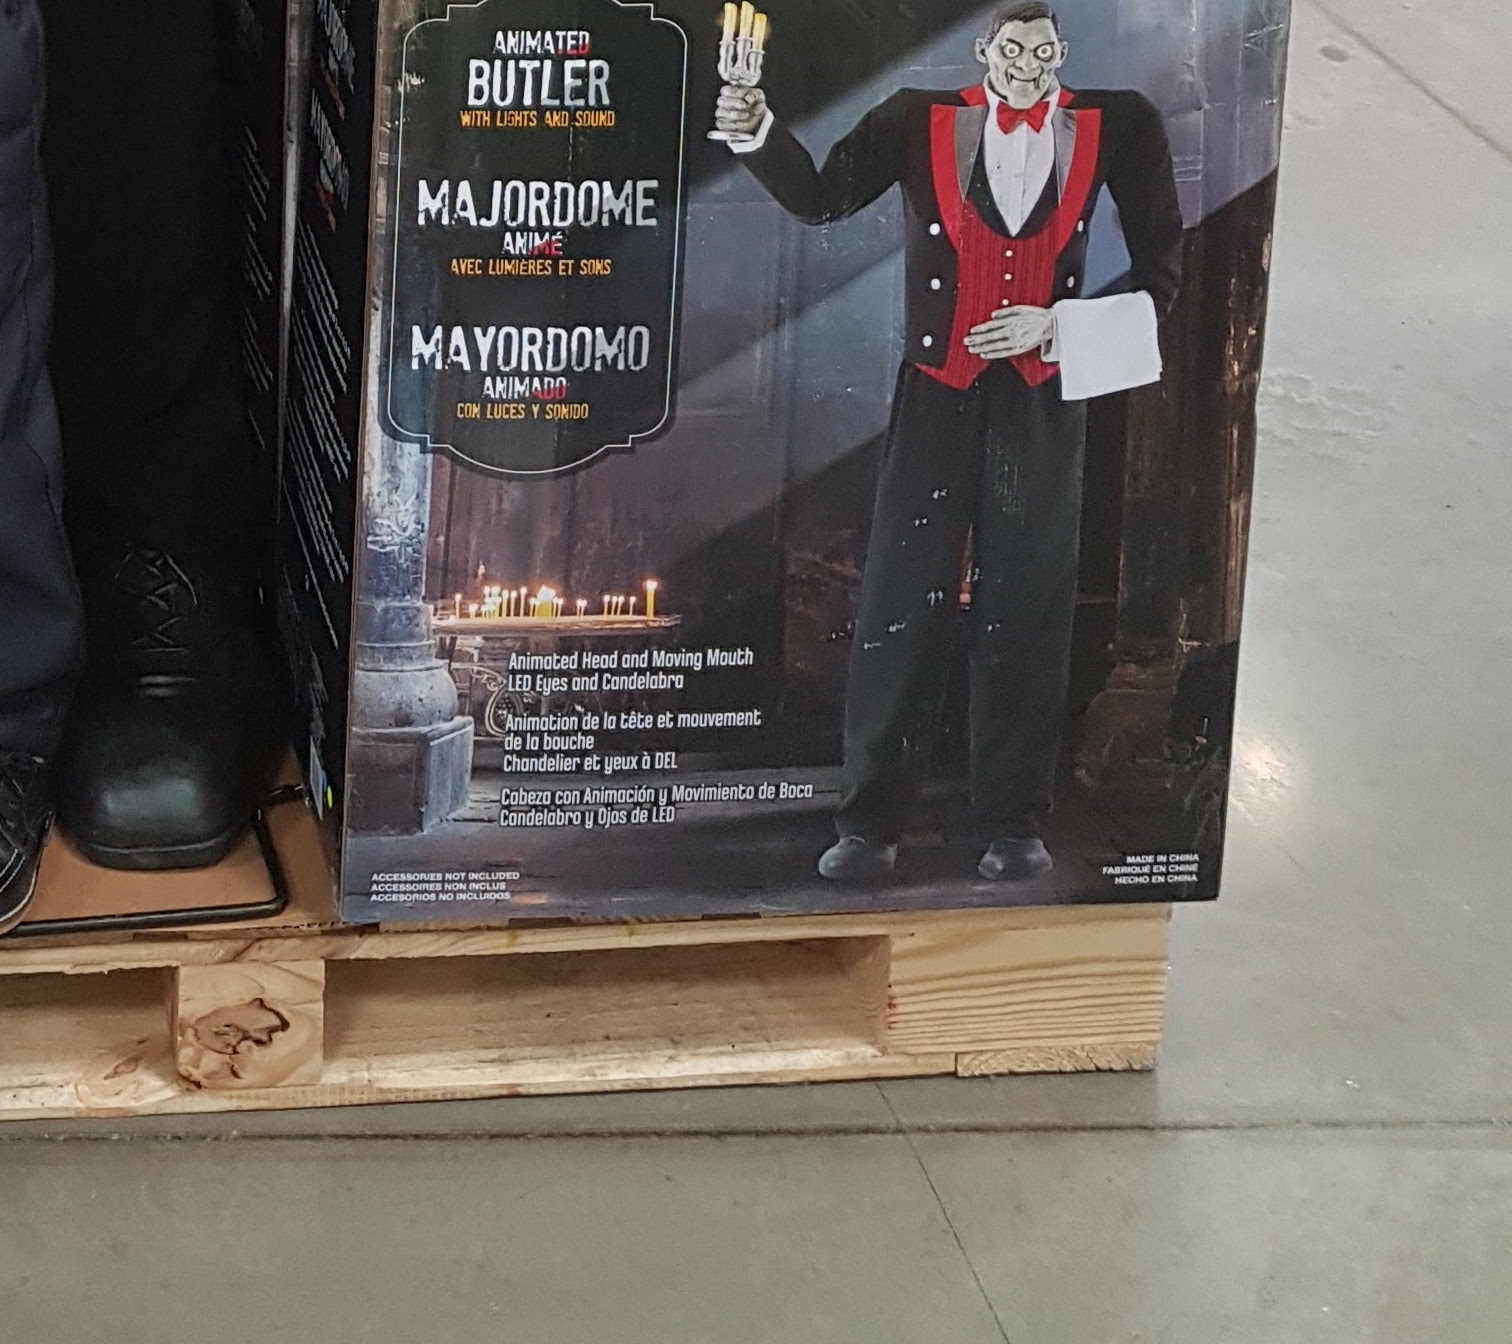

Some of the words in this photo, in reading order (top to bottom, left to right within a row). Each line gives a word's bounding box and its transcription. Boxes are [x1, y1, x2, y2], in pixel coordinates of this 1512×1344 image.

[494, 31, 589, 54] ANIMATED
[468, 58, 610, 107] BUTLER
[417, 179, 658, 226] MAJORDOME
[502, 231, 563, 256] ANIMÉ
[411, 325, 650, 372] MAYORDOMO
[483, 376, 567, 400] ANIMADO
